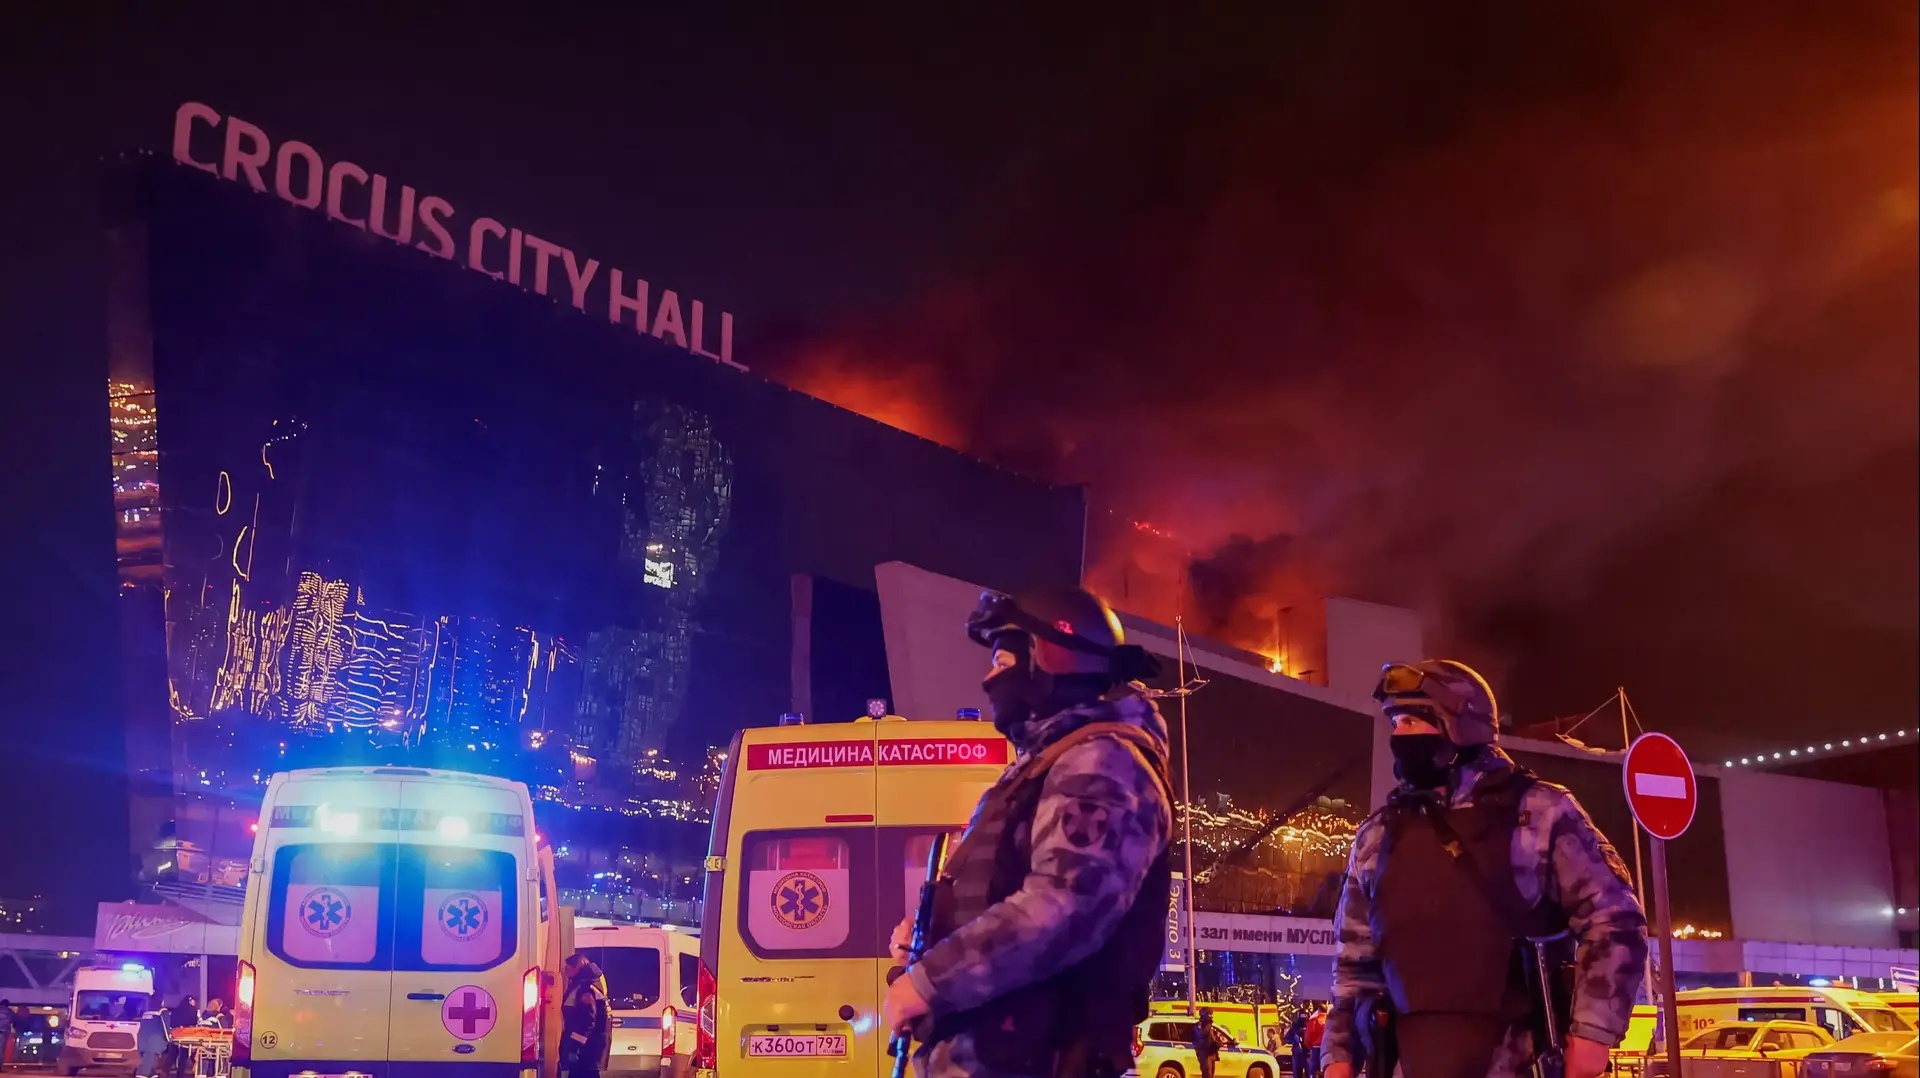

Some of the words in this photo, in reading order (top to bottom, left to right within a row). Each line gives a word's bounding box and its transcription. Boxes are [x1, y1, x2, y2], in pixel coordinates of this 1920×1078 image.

[172, 101, 455, 260] CROCUS
[468, 217, 600, 309] CITY
[609, 268, 750, 373] HALL
[768, 745, 873, 767] МЕДИЦИНА
[878, 743, 987, 761] КАТАСТРОФ
[1201, 927, 1229, 940] зал
[1233, 928, 1282, 942] имени
[1169, 949, 1181, 959] 3
[262, 1035, 276, 1045] 12
[818, 1037, 841, 1048] 797
